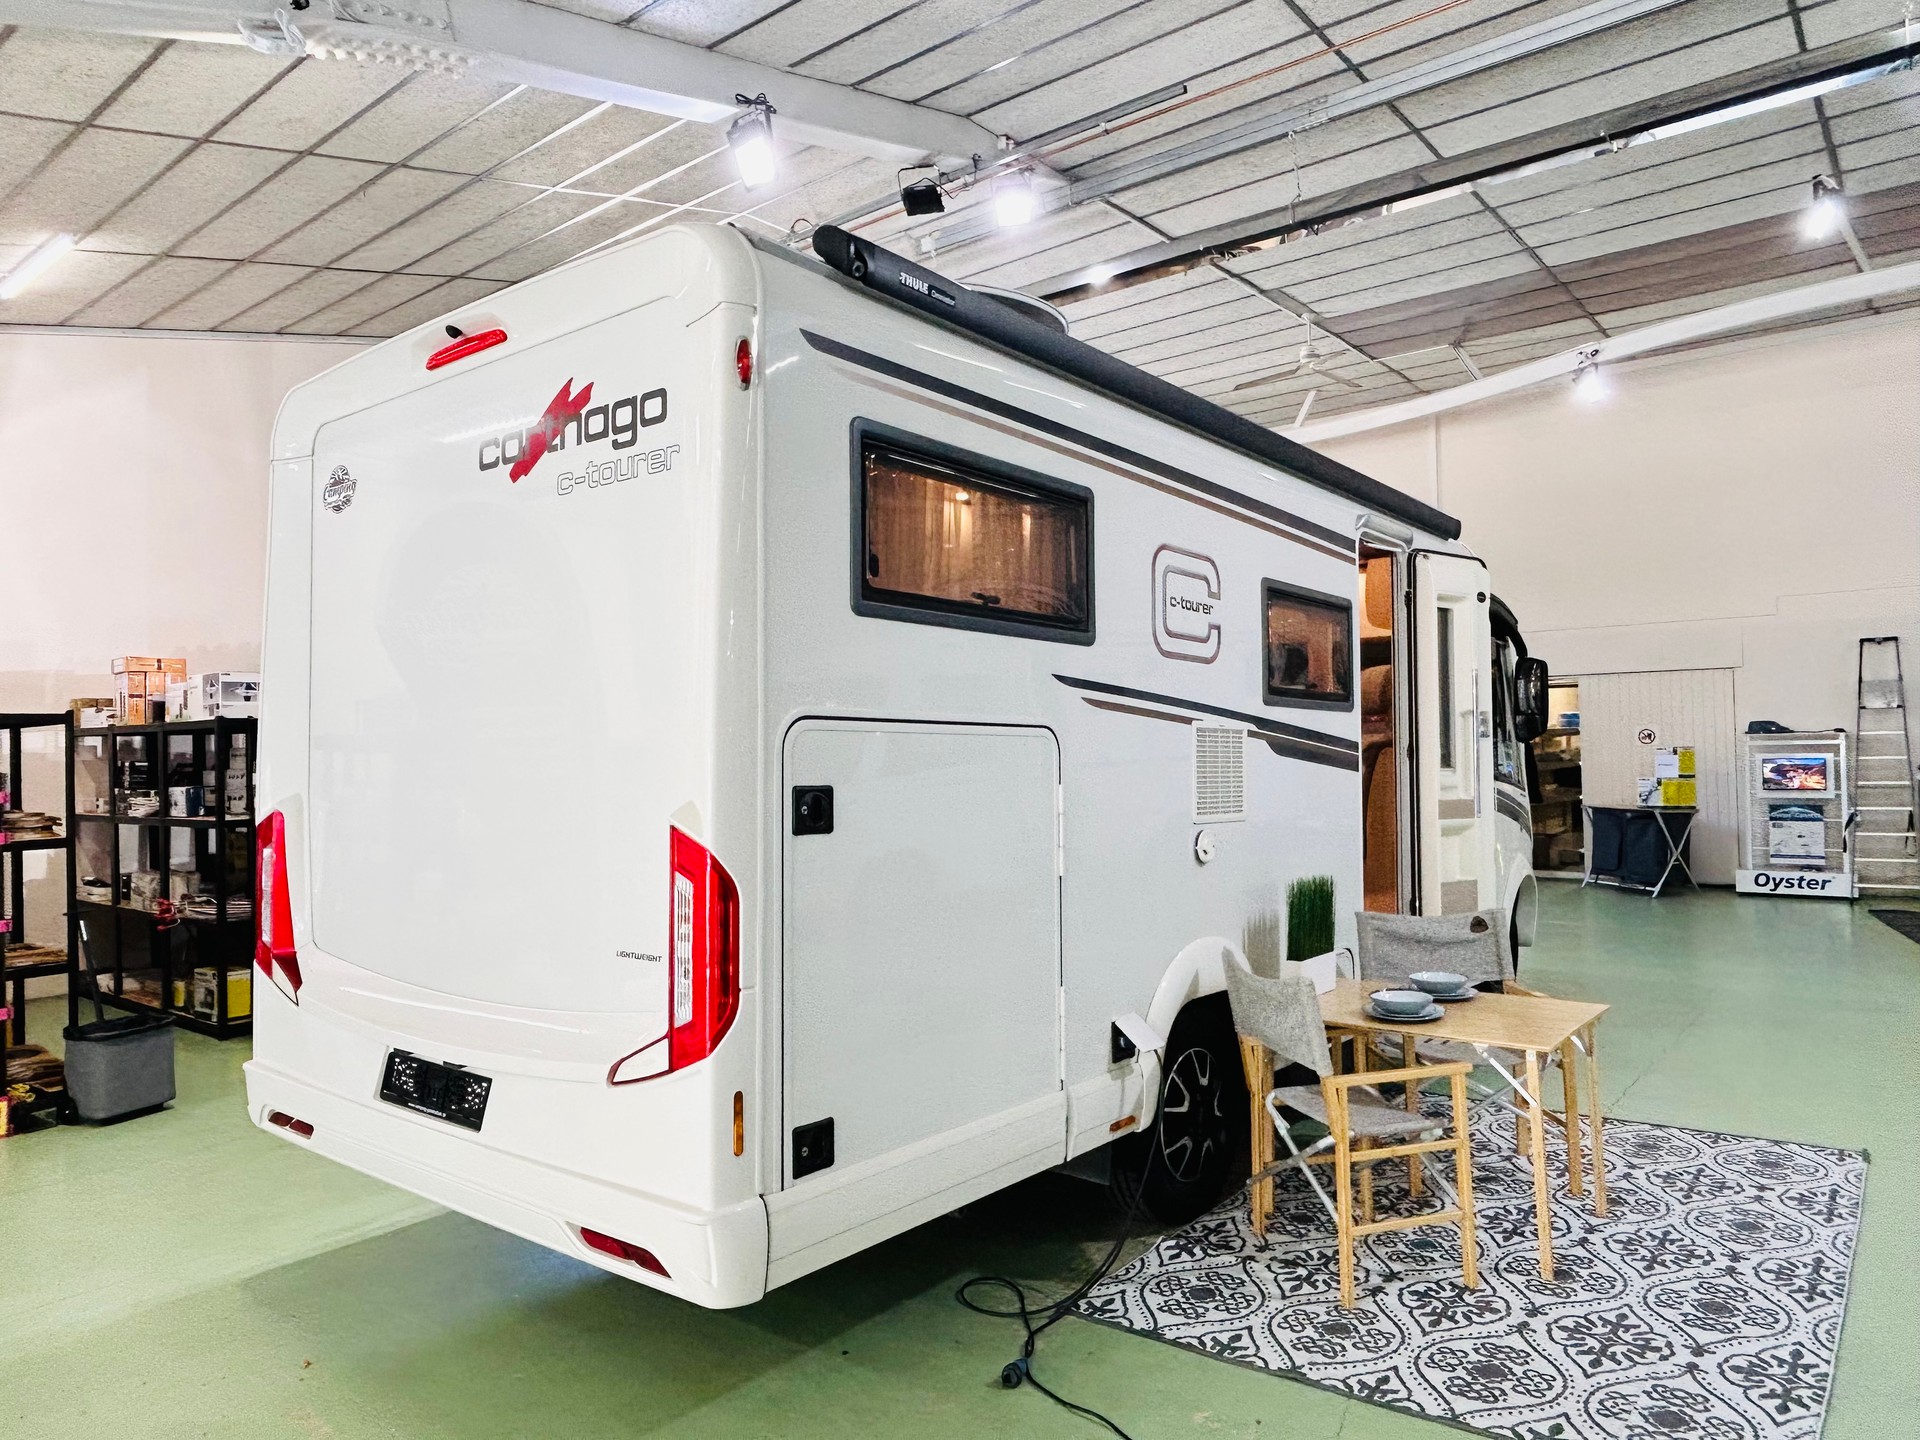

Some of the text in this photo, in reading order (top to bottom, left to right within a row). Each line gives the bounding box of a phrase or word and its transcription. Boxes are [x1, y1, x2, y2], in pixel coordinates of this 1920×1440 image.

[899, 271, 929, 295] THULE
[556, 443, 681, 496] c-tourer
[1169, 595, 1214, 615] c-tourer
[1753, 872, 1832, 892] Oyster
[616, 950, 663, 963] LIGHTWEIGHT
